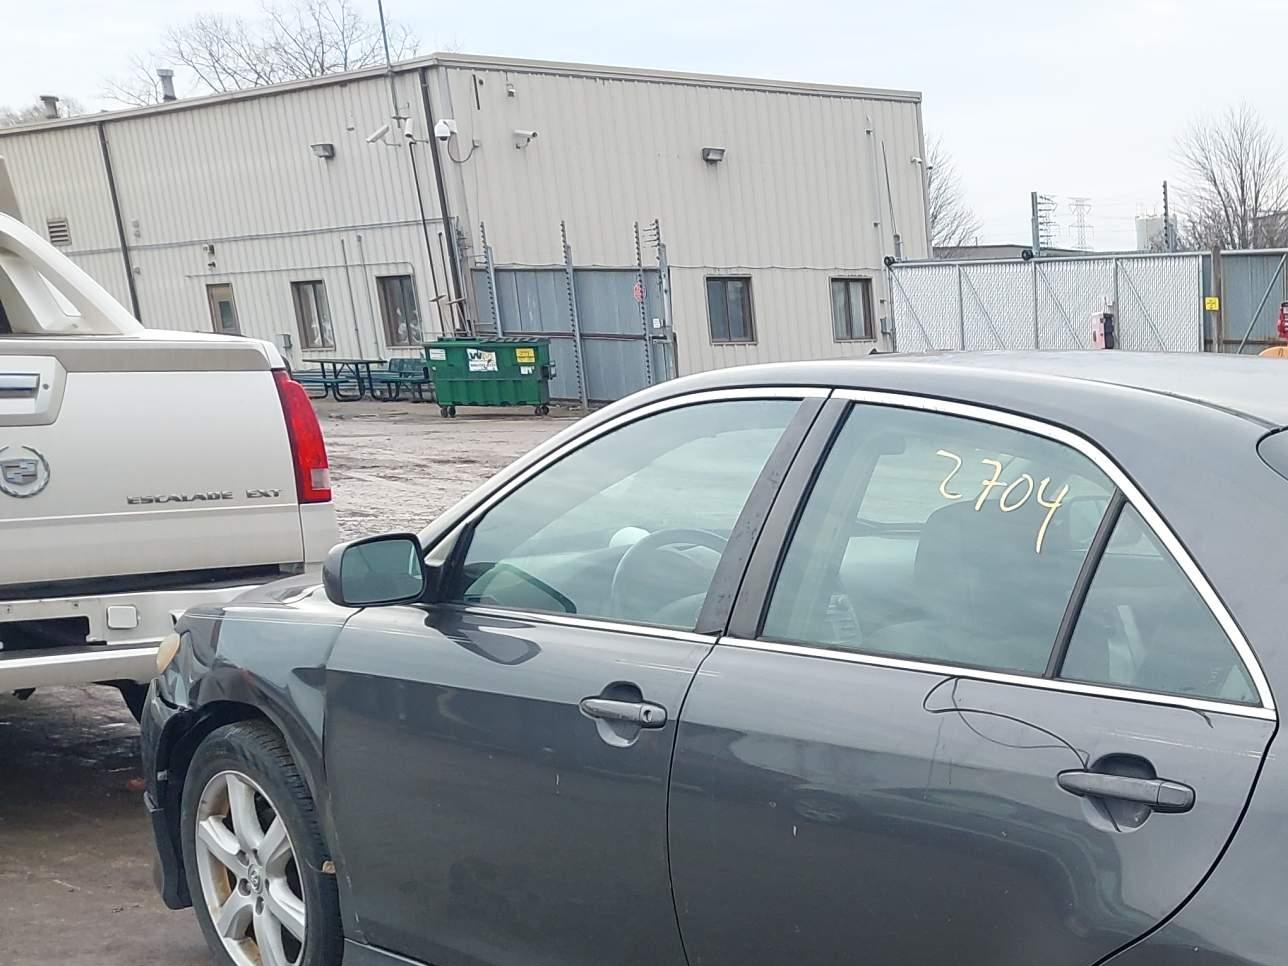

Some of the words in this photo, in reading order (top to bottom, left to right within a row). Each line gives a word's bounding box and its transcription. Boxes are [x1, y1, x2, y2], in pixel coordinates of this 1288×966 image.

[127, 490, 233, 505] ESCALADE
[246, 489, 281, 499] EXT
[936, 449, 1069, 553] 2704
